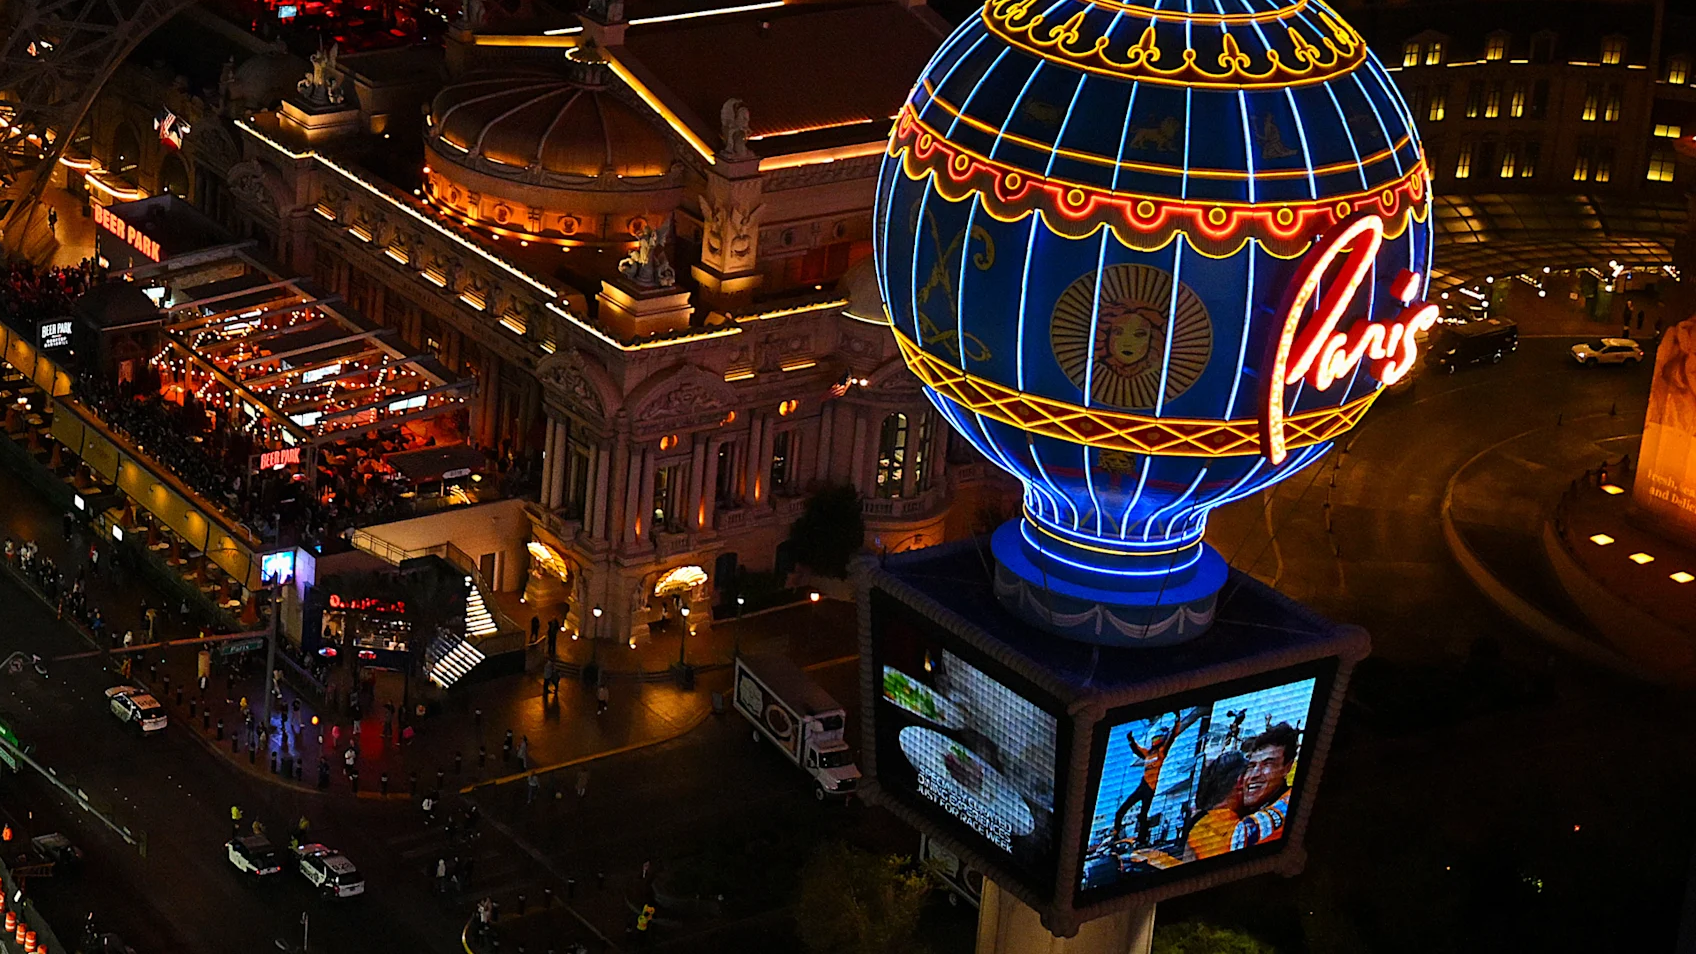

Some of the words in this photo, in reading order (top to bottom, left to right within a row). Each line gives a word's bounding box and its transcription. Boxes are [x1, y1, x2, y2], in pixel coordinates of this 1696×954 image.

[94, 203, 126, 240] BEER
[127, 224, 161, 263] PARK
[41, 324, 57, 338] BEER
[57, 321, 72, 334] PARK
[1268, 214, 1440, 466] Paris
[260, 451, 280, 470] BEER
[280, 448, 300, 464] PARK
[1649, 487, 1670, 500] and
[916, 785, 939, 803] JUST
[940, 799, 959, 818] FOR
[960, 811, 985, 836] RACE
[986, 829, 1013, 854] WEEK
[917, 773, 948, 801] DINING
[949, 796, 1012, 844] EXPERIENCES
[968, 797, 1012, 834] CURATED
